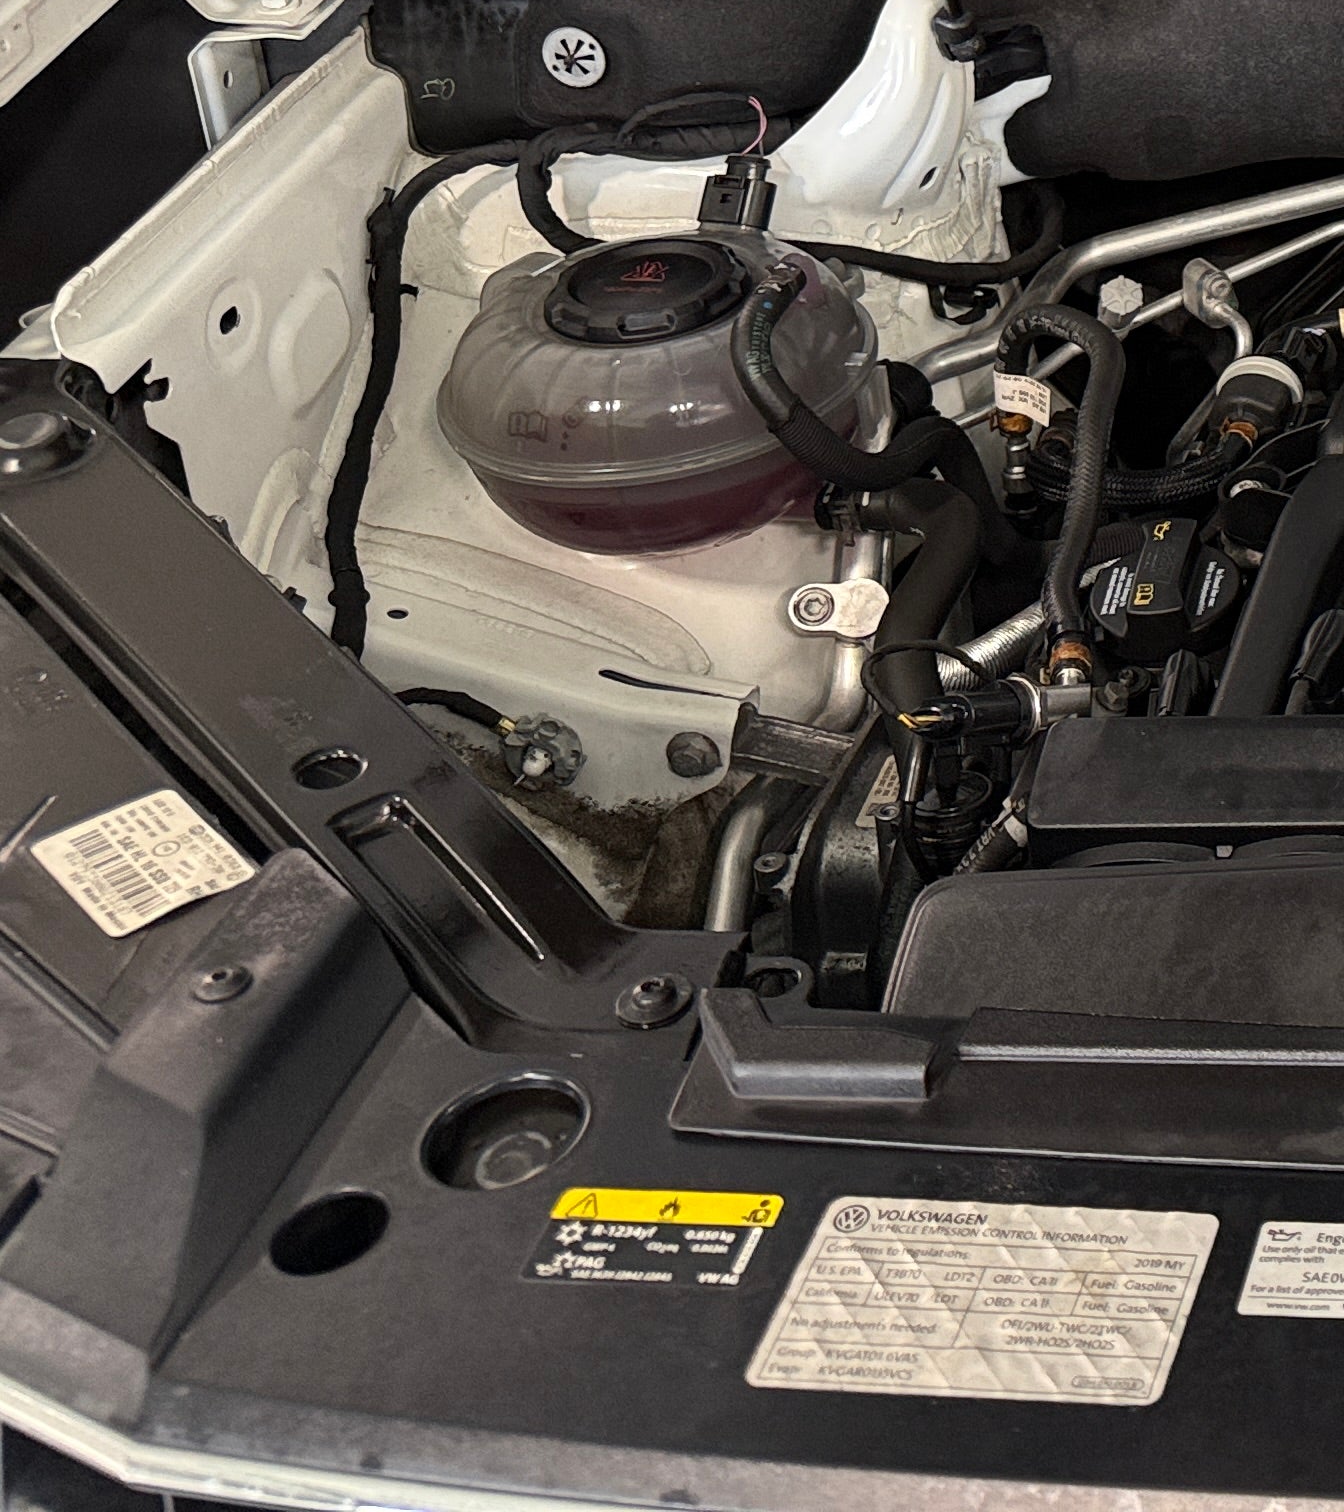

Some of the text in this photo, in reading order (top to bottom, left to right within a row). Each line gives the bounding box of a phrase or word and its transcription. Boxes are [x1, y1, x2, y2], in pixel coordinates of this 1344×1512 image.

[877, 1209, 989, 1226] VOLKSWAGEN
[591, 1224, 658, 1240] R-1234yf
[871, 1223, 1129, 1245] VEHICLE EMISSION CONTROL INFORMATION
[827, 1243, 900, 1256] Conforms to
[1262, 1245, 1282, 1254] Use
[1282, 1246, 1302, 1256] only
[1303, 1246, 1317, 1255] oil
[1318, 1246, 1338, 1255] that
[573, 1255, 606, 1269] PAG
[1134, 1258, 1187, 1270] 2019 MY
[1259, 1255, 1326, 1265] complies with
[697, 1272, 740, 1285] VW AG
[1091, 1278, 1177, 1293] Fuel: Gasoline
[1250, 1284, 1267, 1294] For
[1275, 1285, 1291, 1295] list
[1291, 1285, 1305, 1295] of
[1082, 1300, 1169, 1316] Fuel: Gasoline
[790, 1316, 809, 1328] No
[810, 1317, 887, 1332] adjustments
